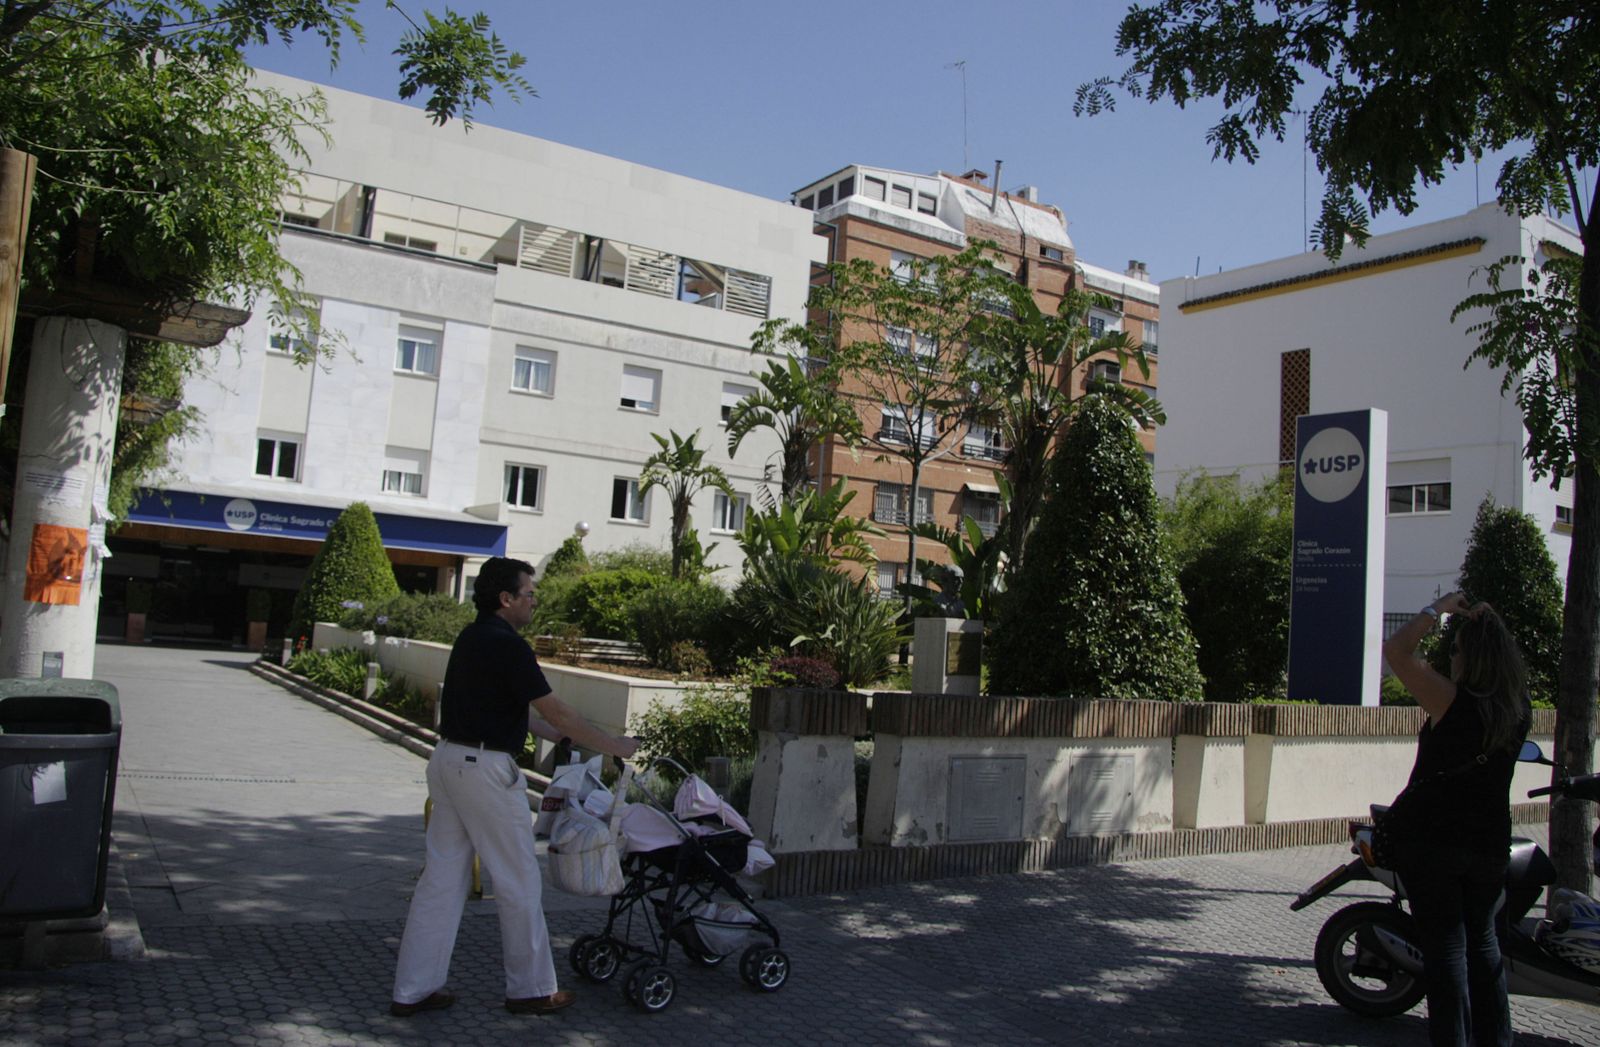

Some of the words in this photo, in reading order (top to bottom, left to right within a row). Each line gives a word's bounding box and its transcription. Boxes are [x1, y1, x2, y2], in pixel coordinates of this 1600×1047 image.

[1319, 455, 1360, 473] USP
[290, 515, 325, 526] Sagrado
[1296, 576, 1327, 584] Urgencias
